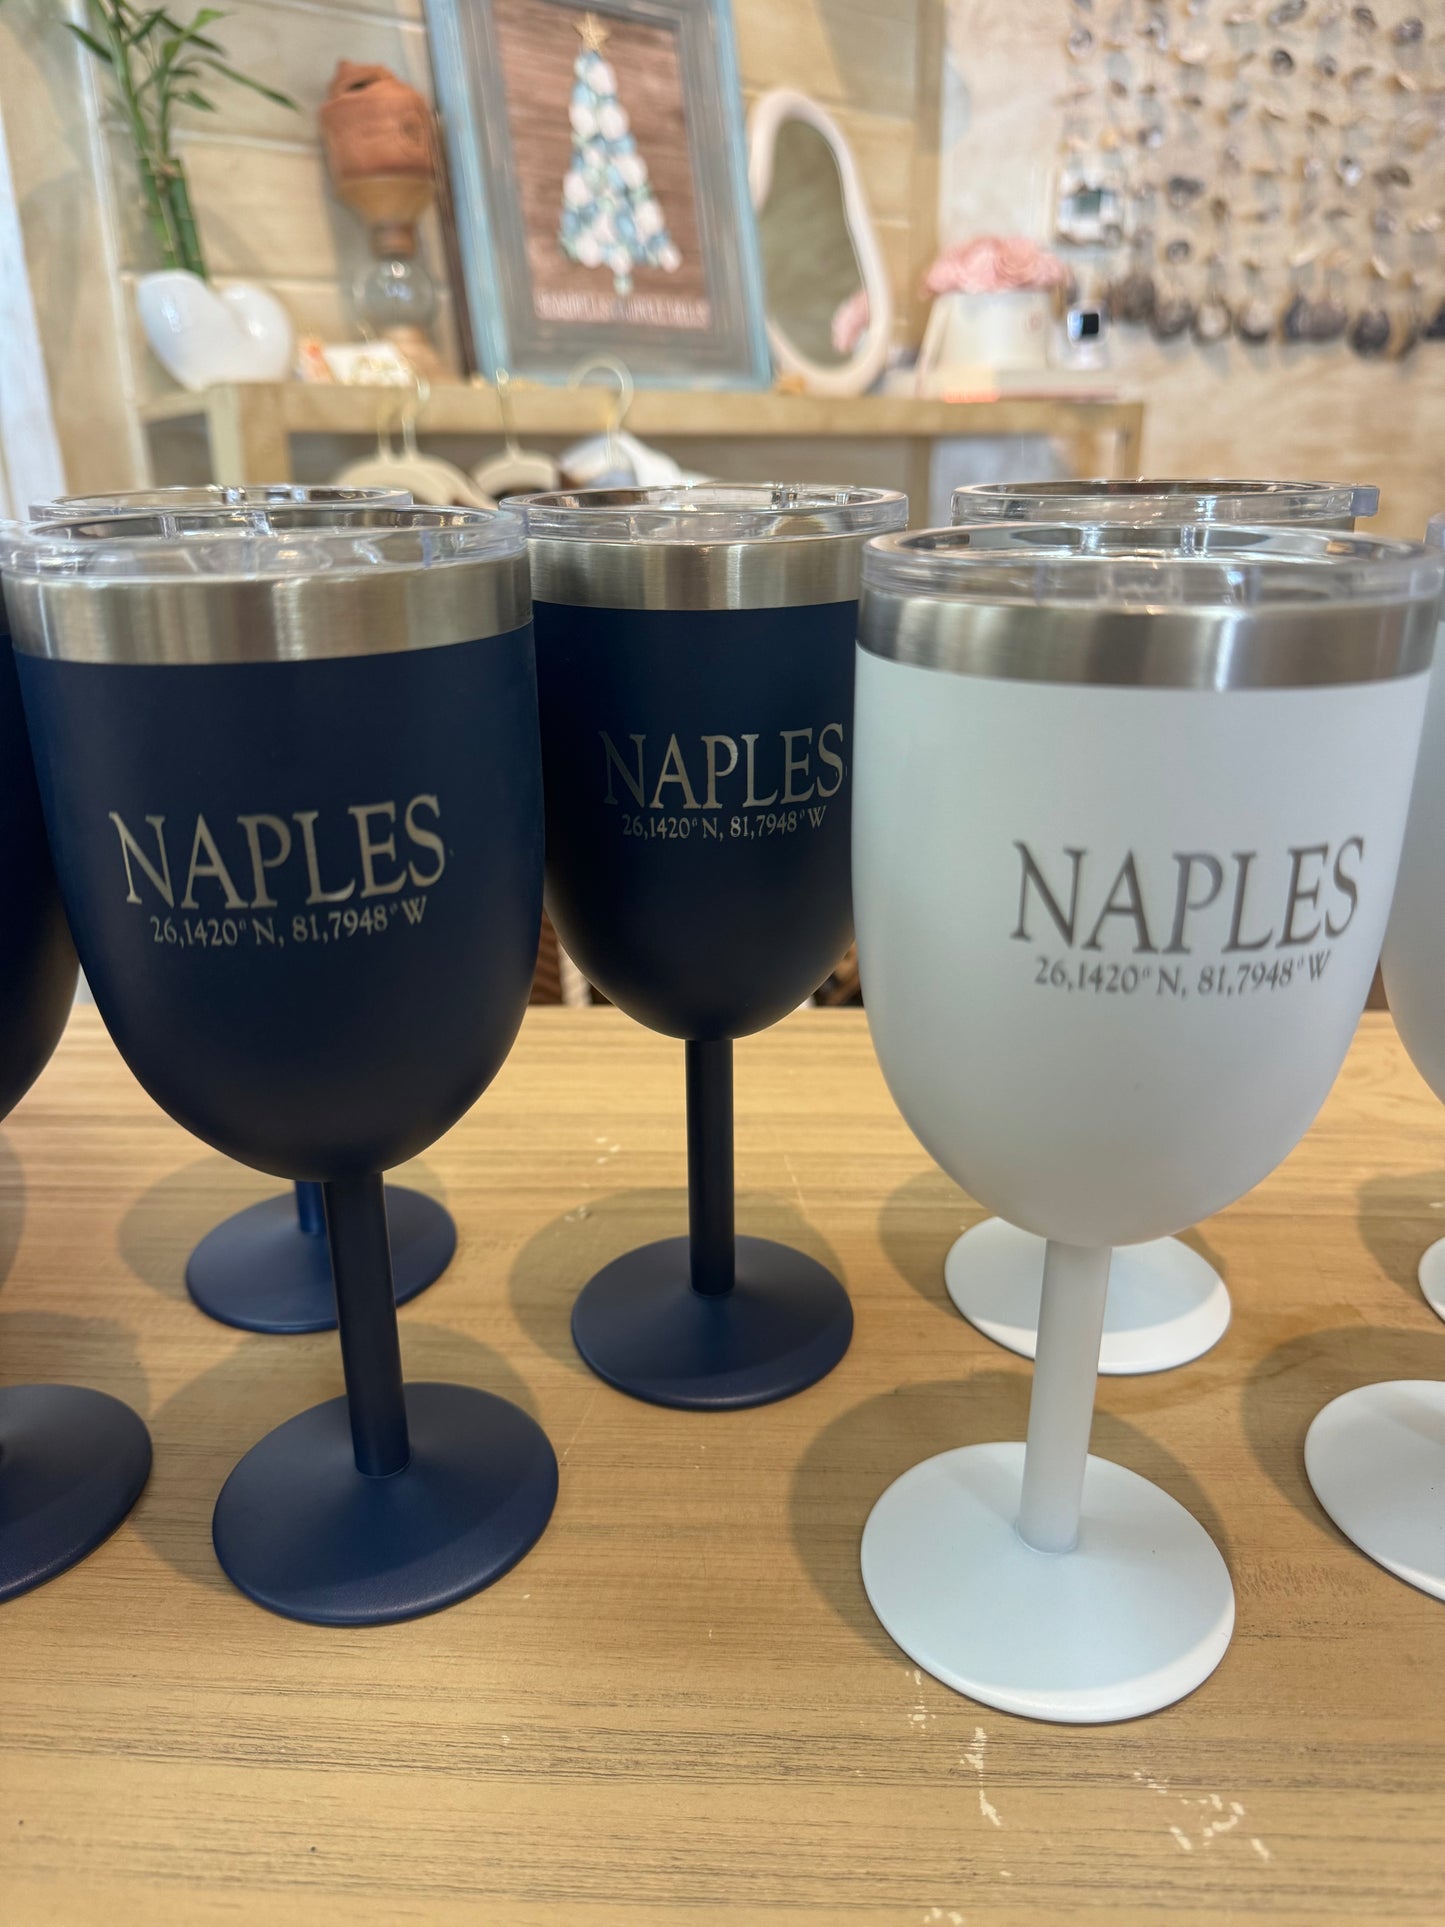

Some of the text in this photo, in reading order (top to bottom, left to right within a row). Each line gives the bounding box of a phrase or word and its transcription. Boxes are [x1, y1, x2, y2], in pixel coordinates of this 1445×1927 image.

[598, 723, 844, 809] NAPLES
[108, 793, 446, 909] NAPLES
[1009, 835, 1365, 955] NAPLES
